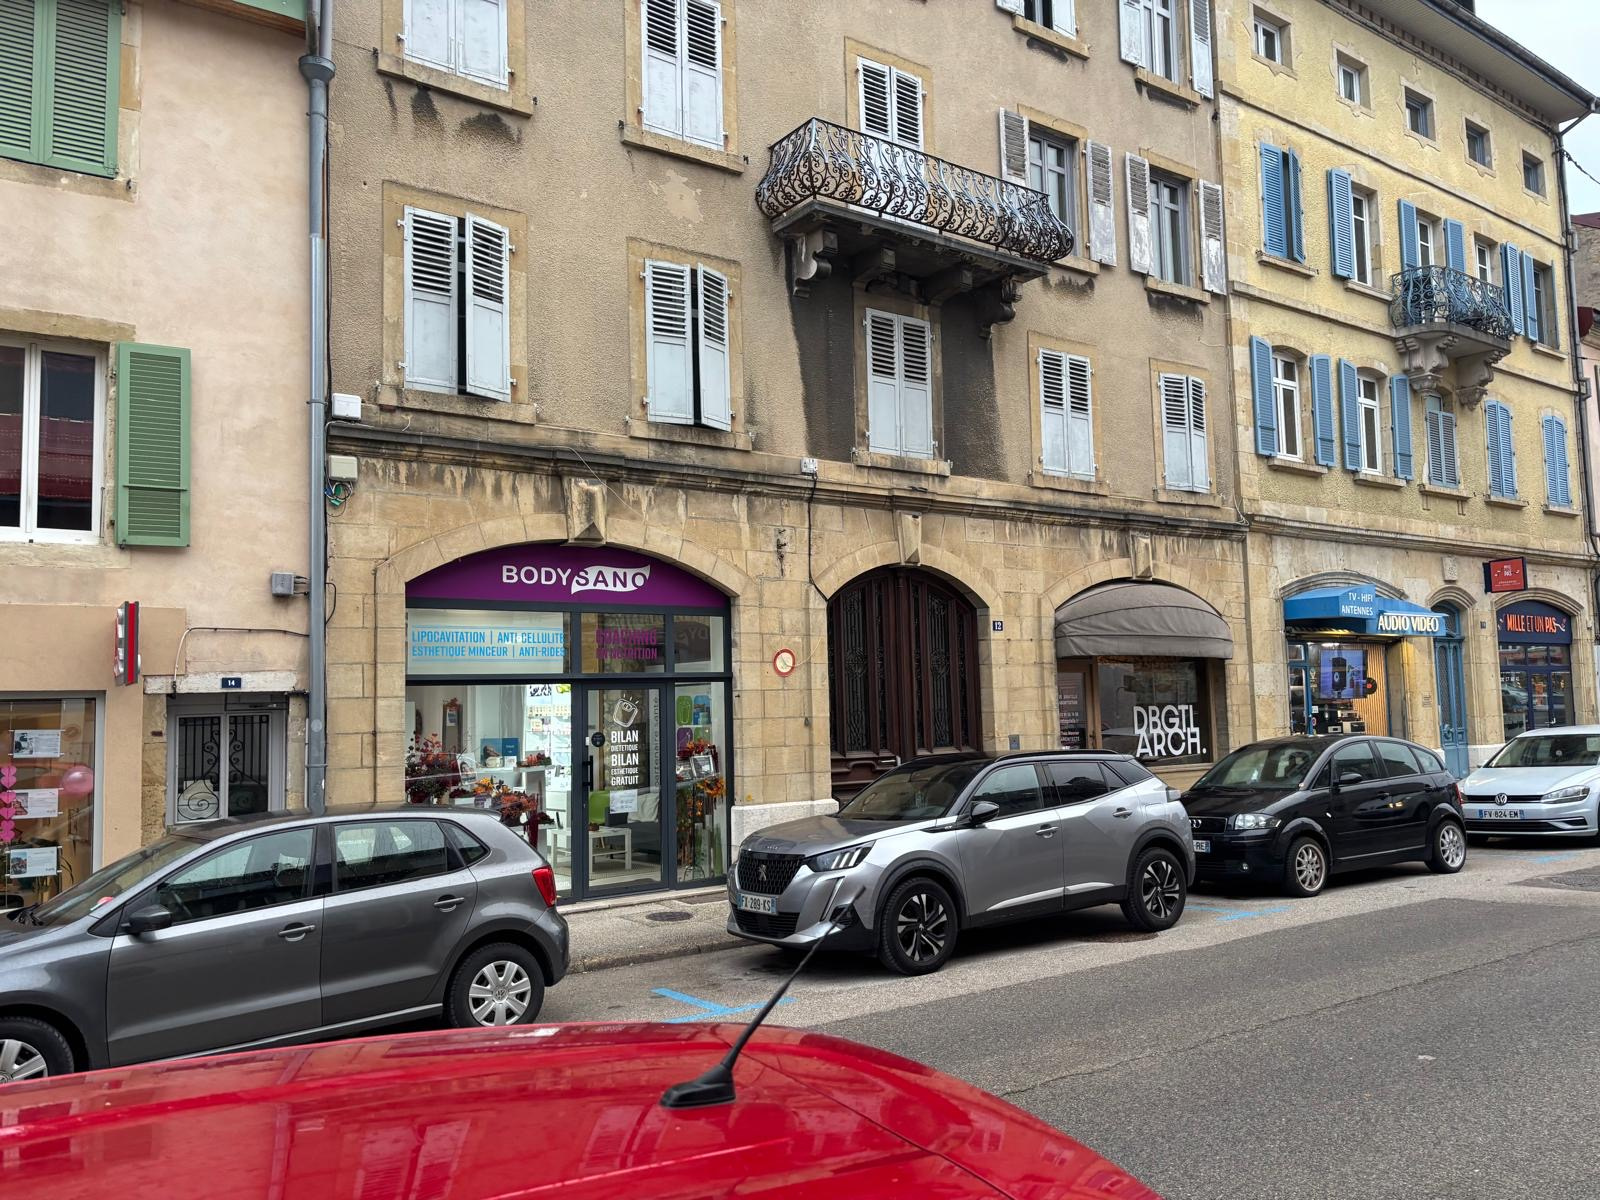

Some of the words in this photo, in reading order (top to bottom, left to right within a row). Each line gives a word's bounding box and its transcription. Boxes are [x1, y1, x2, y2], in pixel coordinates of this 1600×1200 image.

[1361, 594, 1373, 602] HIFI
[1341, 605, 1374, 616] ANTENNES
[994, 621, 1002, 630] 12
[1378, 615, 1409, 631] AUDIO
[1410, 616, 1440, 632] VIDEO
[1506, 613, 1526, 632] MILLE
[1526, 615, 1534, 633] ET
[1535, 616, 1545, 632] UN
[1545, 616, 1557, 633] PAS
[411, 630, 486, 643] LIPOCAVITATION
[497, 631, 565, 644] ANTI-CELLULITE
[468, 645, 508, 656] MINCEUR
[518, 646, 566, 657] ANTI-RIDES
[227, 679, 236, 687] 14
[611, 730, 639, 743] BILAN
[611, 753, 639, 766] BILAN
[611, 775, 639, 786] GRATUIT
